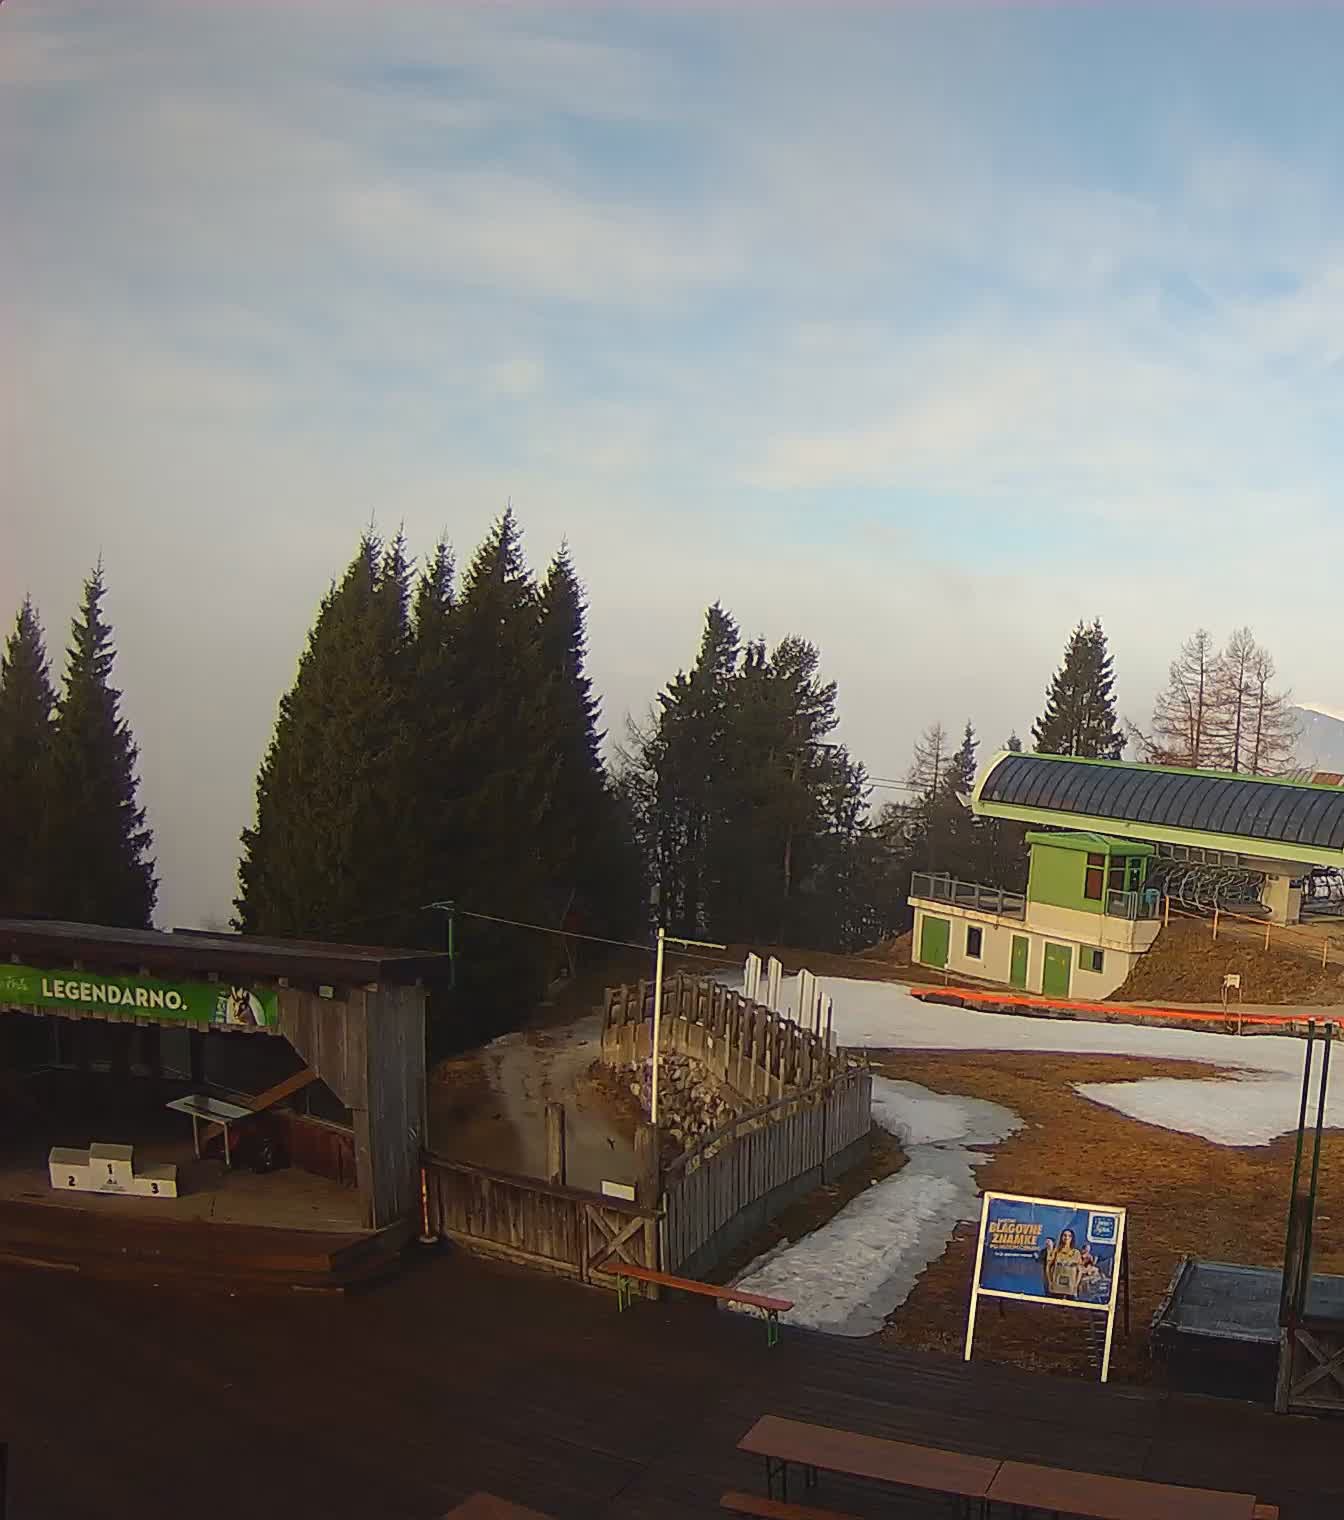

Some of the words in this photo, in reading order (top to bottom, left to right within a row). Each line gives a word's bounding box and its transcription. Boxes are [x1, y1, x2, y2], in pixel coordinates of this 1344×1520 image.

[41, 978, 189, 1011] LEGENDARNO.
[106, 1163, 114, 1175] 1
[68, 1175, 76, 1187] 2
[150, 1182, 160, 1194] 3
[991, 1233, 1038, 1245] ZNAMKE
